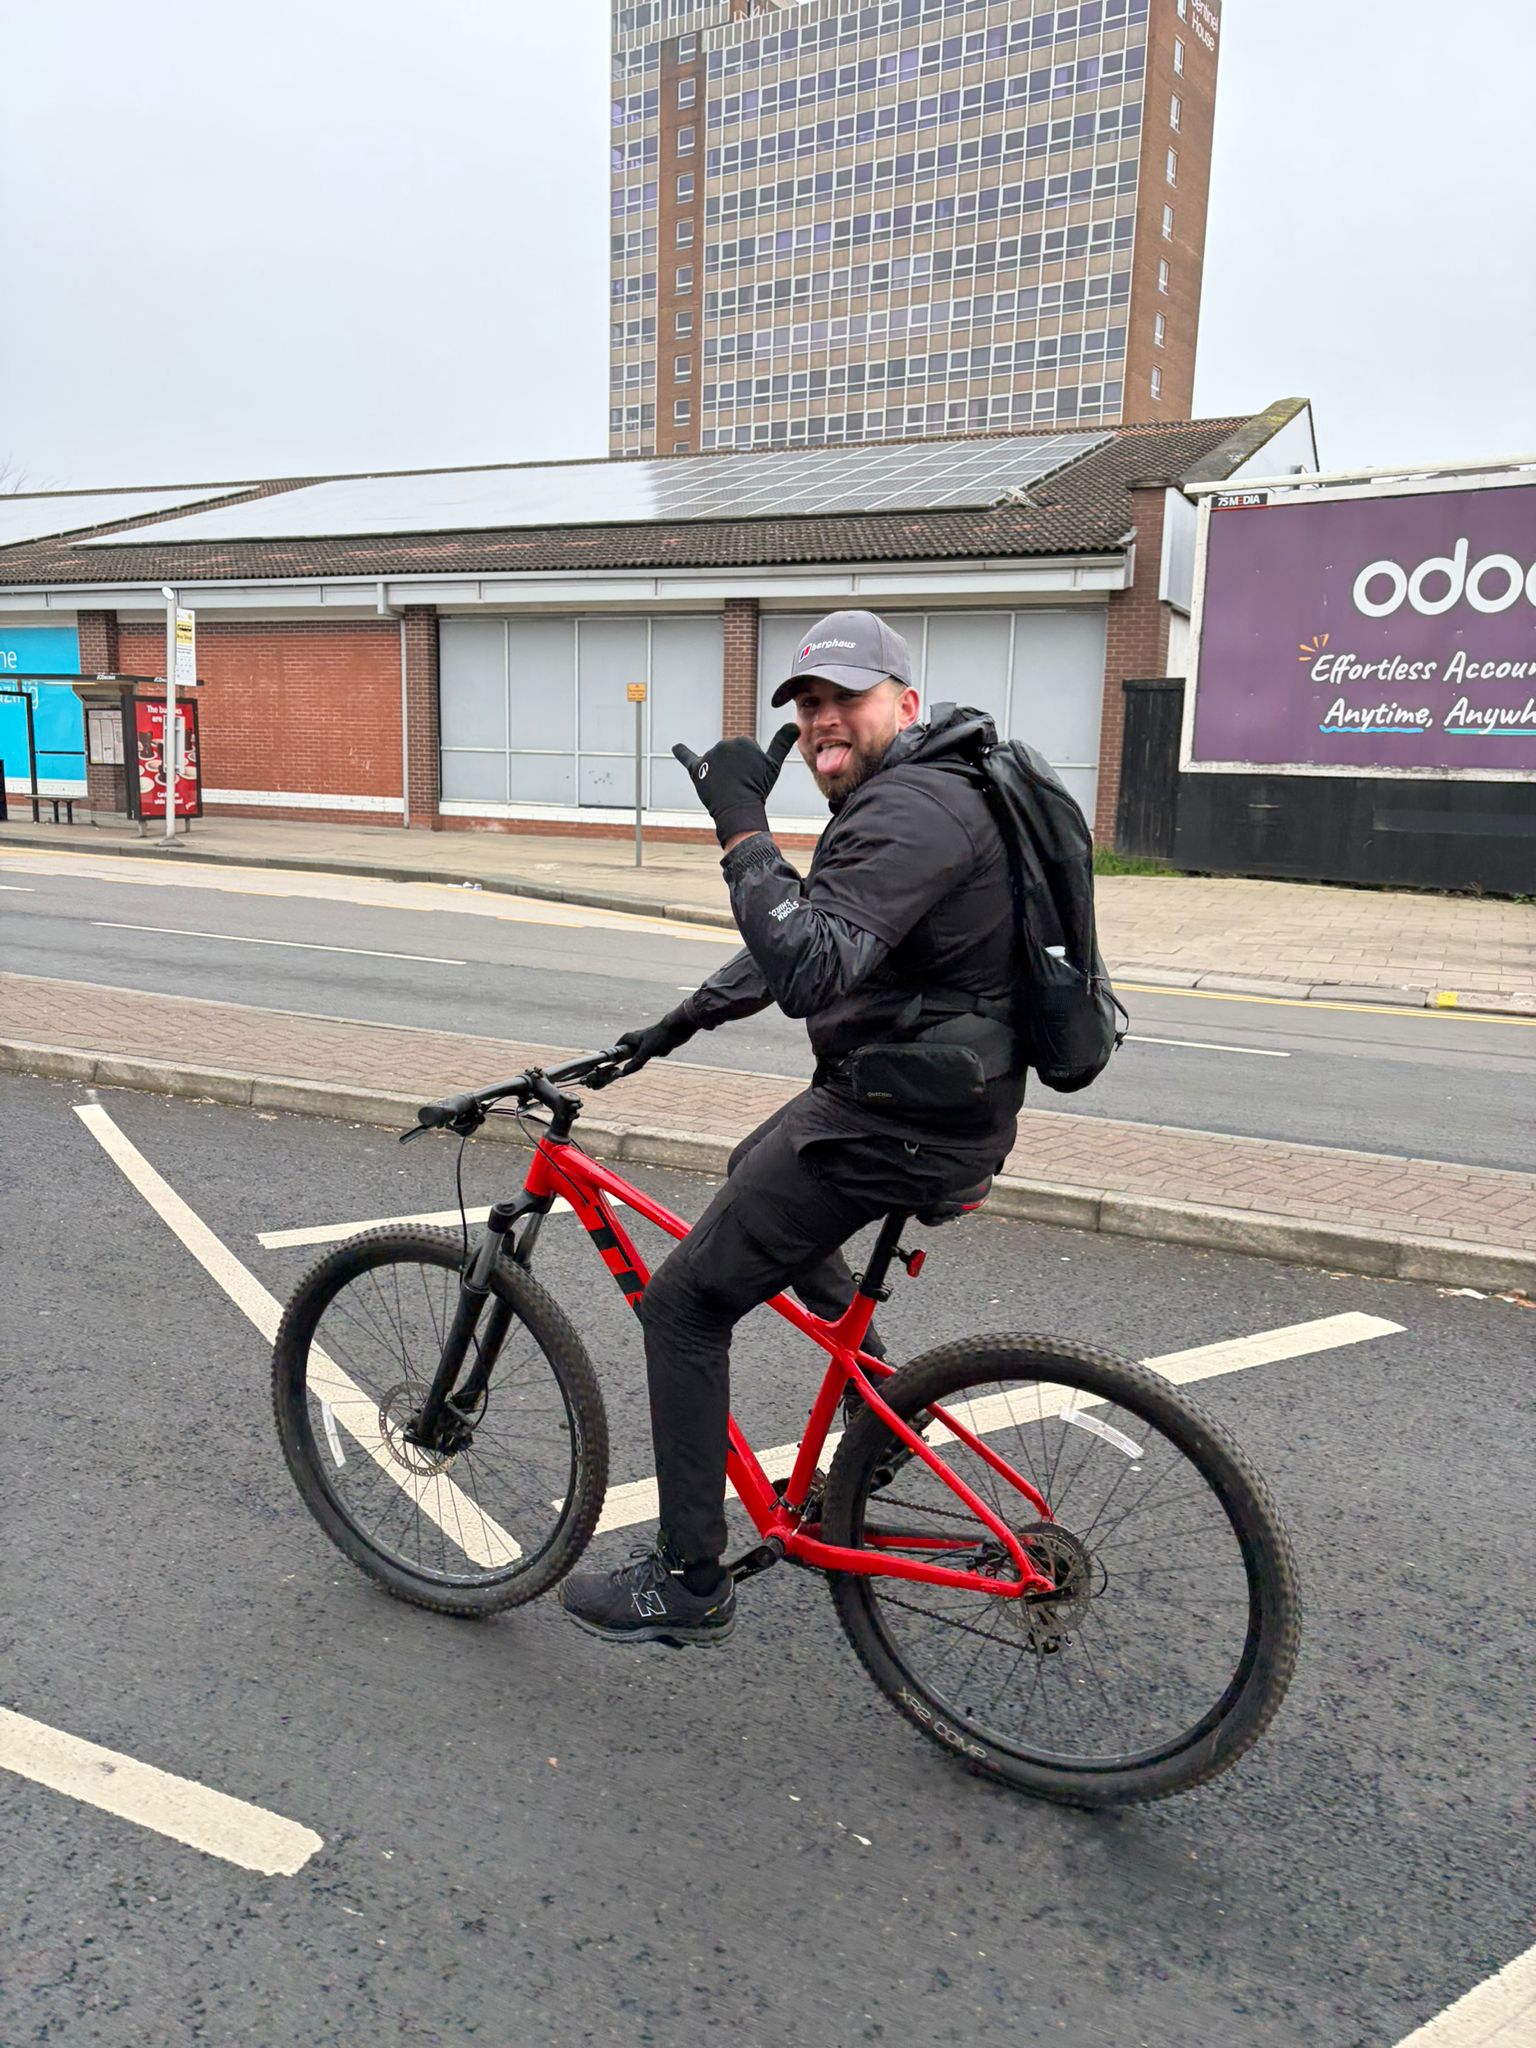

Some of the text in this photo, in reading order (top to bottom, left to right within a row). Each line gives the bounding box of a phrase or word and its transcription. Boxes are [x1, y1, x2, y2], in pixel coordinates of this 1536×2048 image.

[1191, 11, 1215, 51] House
[1353, 538, 1536, 617] odo
[1311, 653, 1437, 684] Effortless
[1324, 698, 1433, 733] Anytime,
[934, 1721, 988, 1758] COMP
